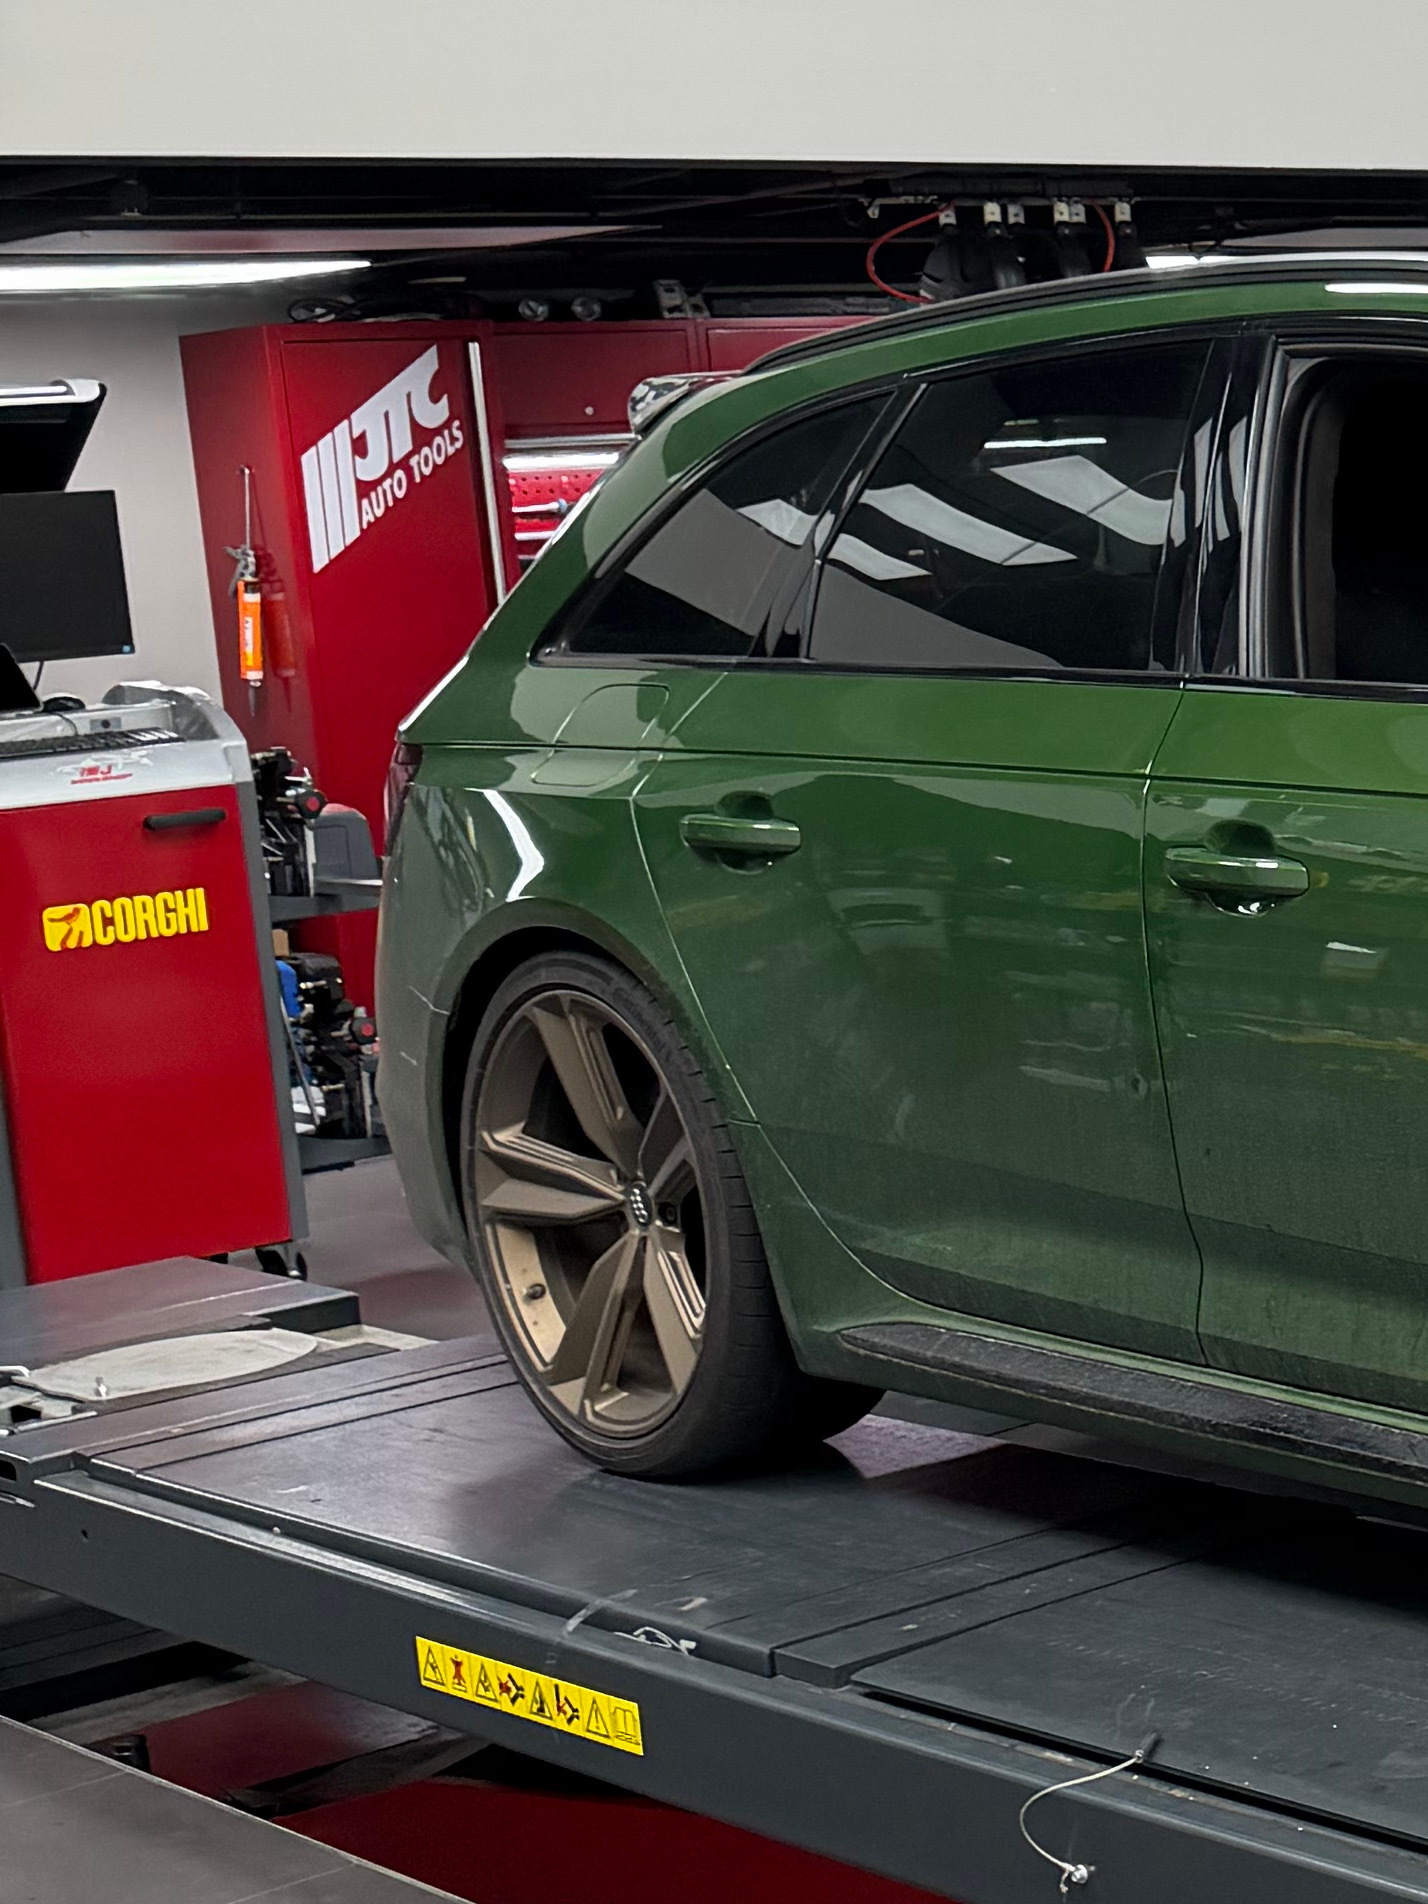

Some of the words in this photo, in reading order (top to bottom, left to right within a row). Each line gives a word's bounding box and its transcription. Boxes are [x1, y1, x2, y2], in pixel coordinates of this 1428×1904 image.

[361, 469, 407, 530] AUTO
[409, 419, 464, 484] TOOLS
[91, 887, 209, 946] CORGHI
